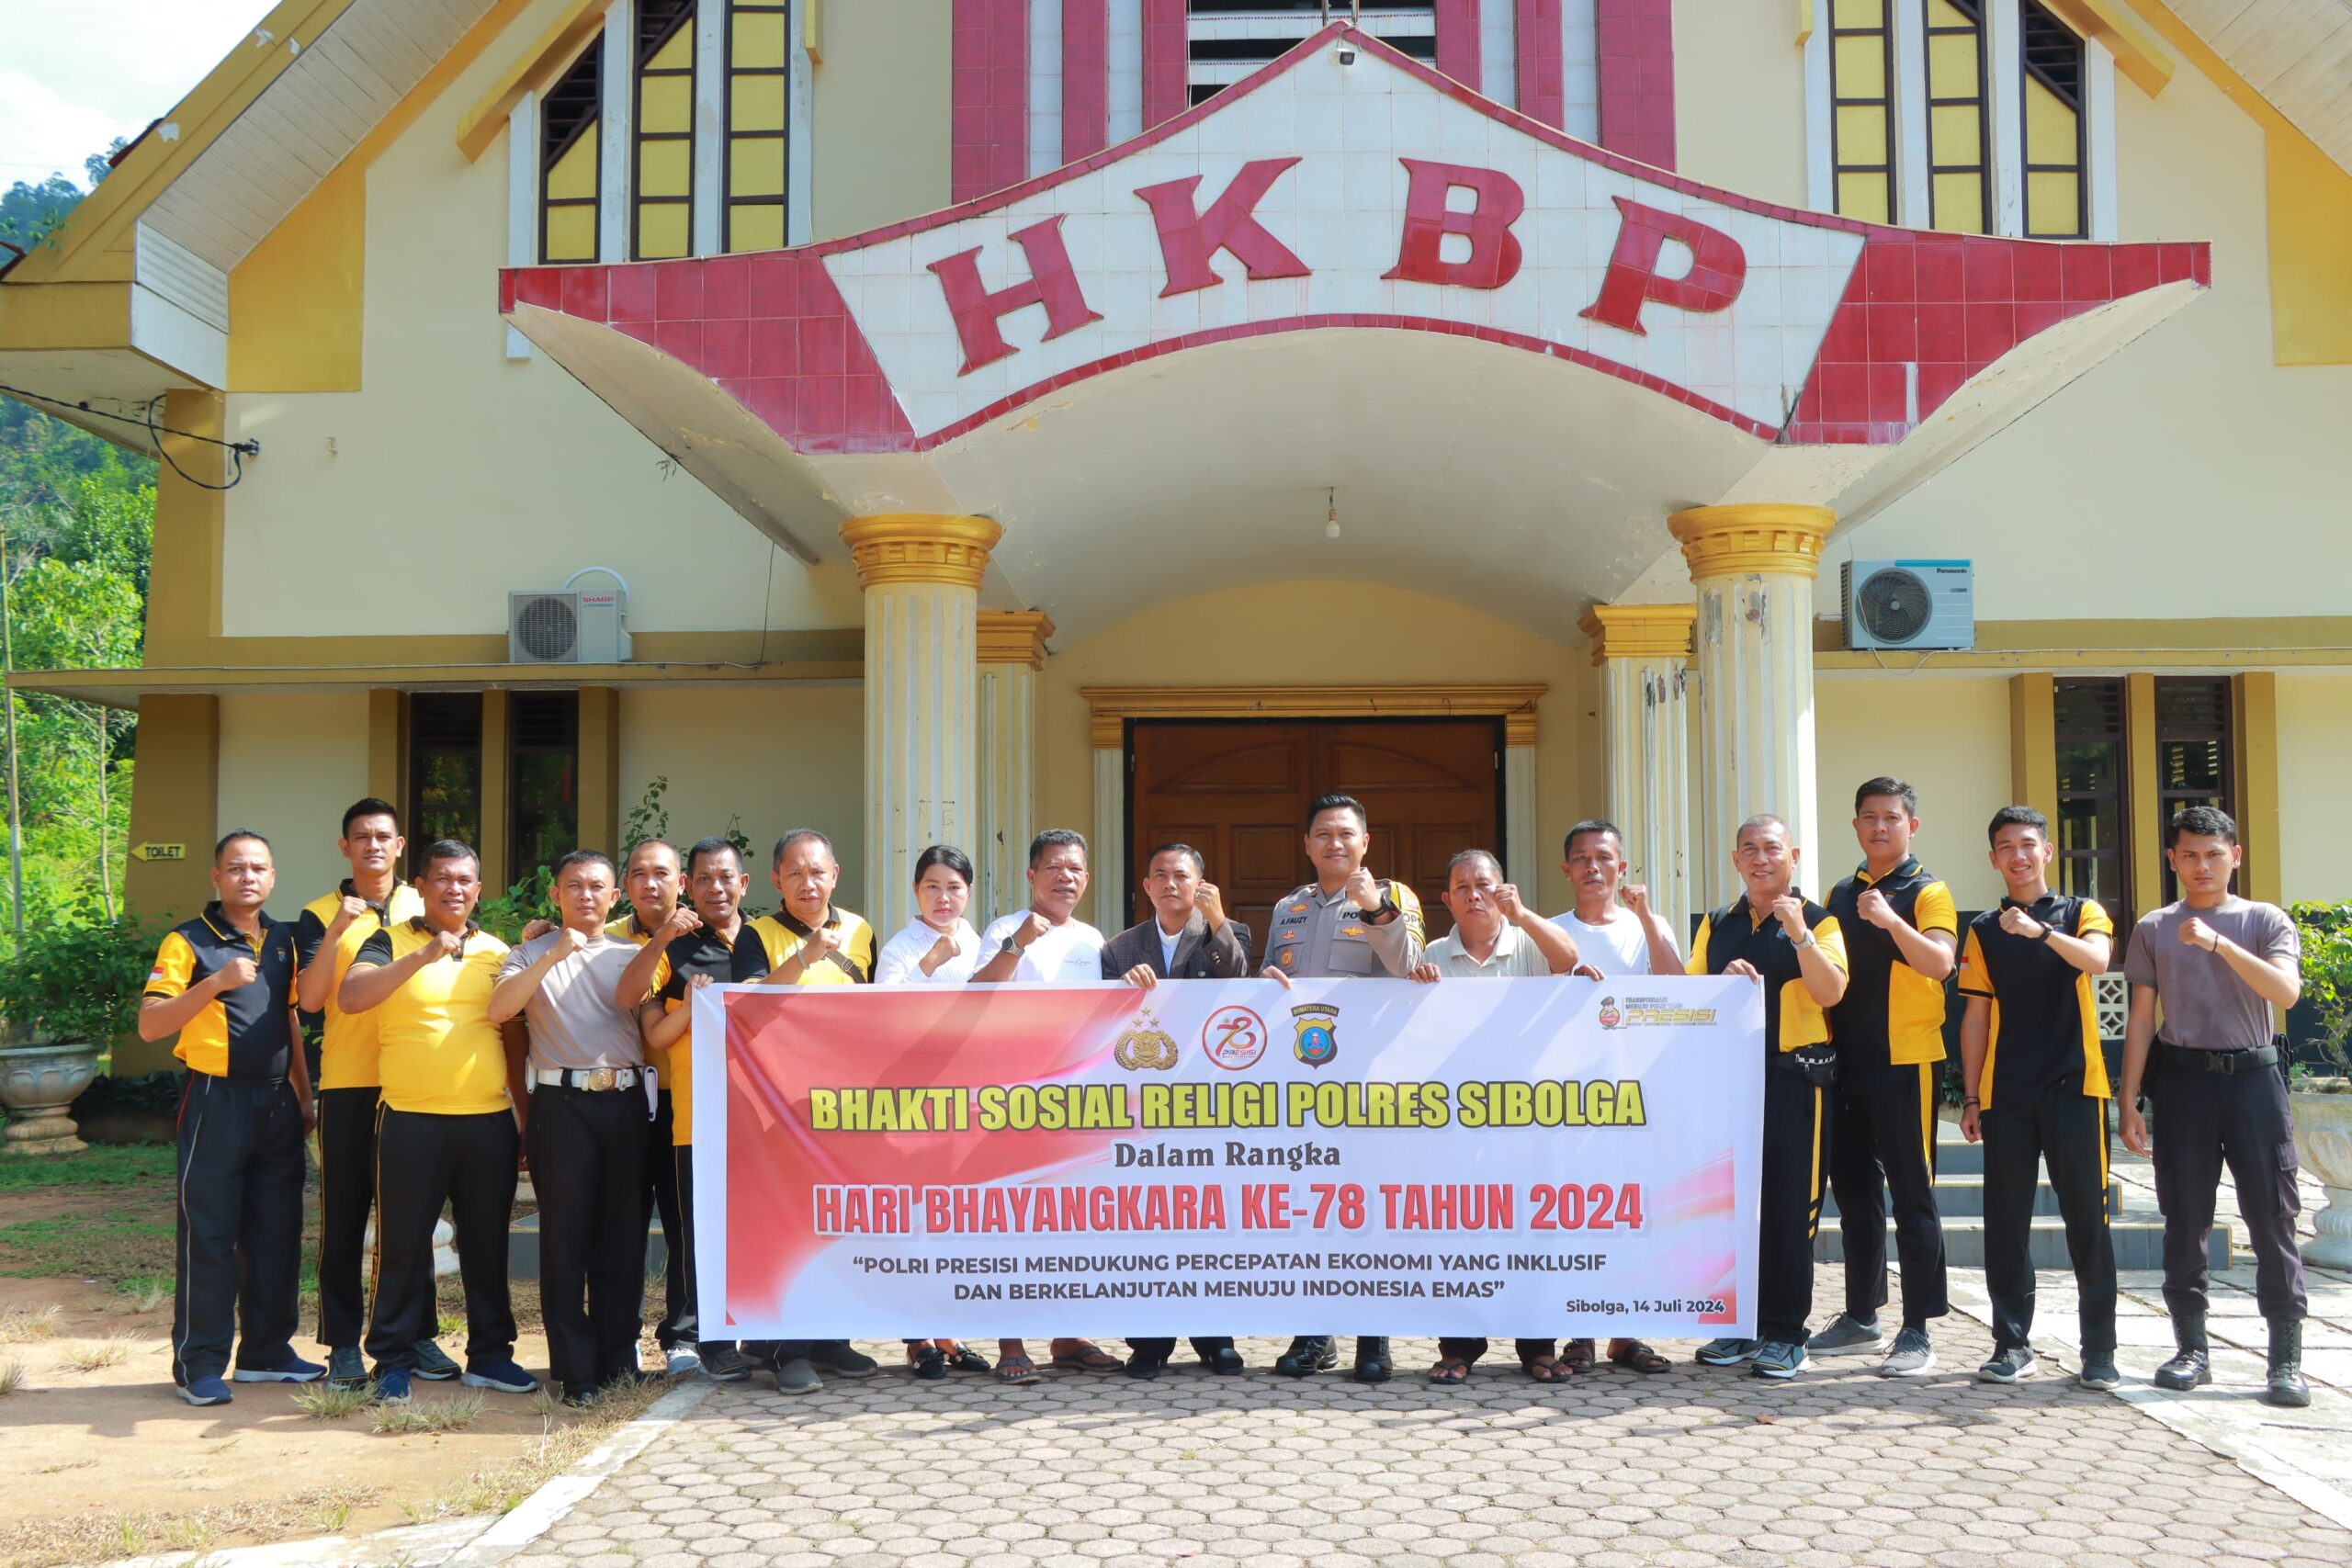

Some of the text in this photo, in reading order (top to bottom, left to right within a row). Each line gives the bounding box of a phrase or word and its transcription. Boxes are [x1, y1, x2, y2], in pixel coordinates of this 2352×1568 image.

[925, 154, 1747, 378] HKBP
[145, 846, 181, 857] TOILET
[1280, 916, 1308, 926] A.FAUZY
[1293, 1005, 1339, 1015] SUMATERA UTARA
[1626, 1009, 1717, 1023] PRESISI
[810, 1079, 1647, 1132] BHAKTI SOSIAL RELIGI POLRES SIBOLGA
[1115, 1142, 1340, 1172] Dalam Rangka
[816, 1183, 1643, 1235] HARI BHAYANGKARA KE-78 TAHUN 2024
[854, 1253, 1607, 1274] “POLRI PRESISI MENDUKUNG PERCEPATAN EKONOMI YANG INKLUSIF
[955, 1280, 1505, 1300] DAN BERKELANJUTAN MENUJU INDONESIA EMAS”
[1566, 1299, 1725, 1315] Sibolga, 14 Juli 2024
